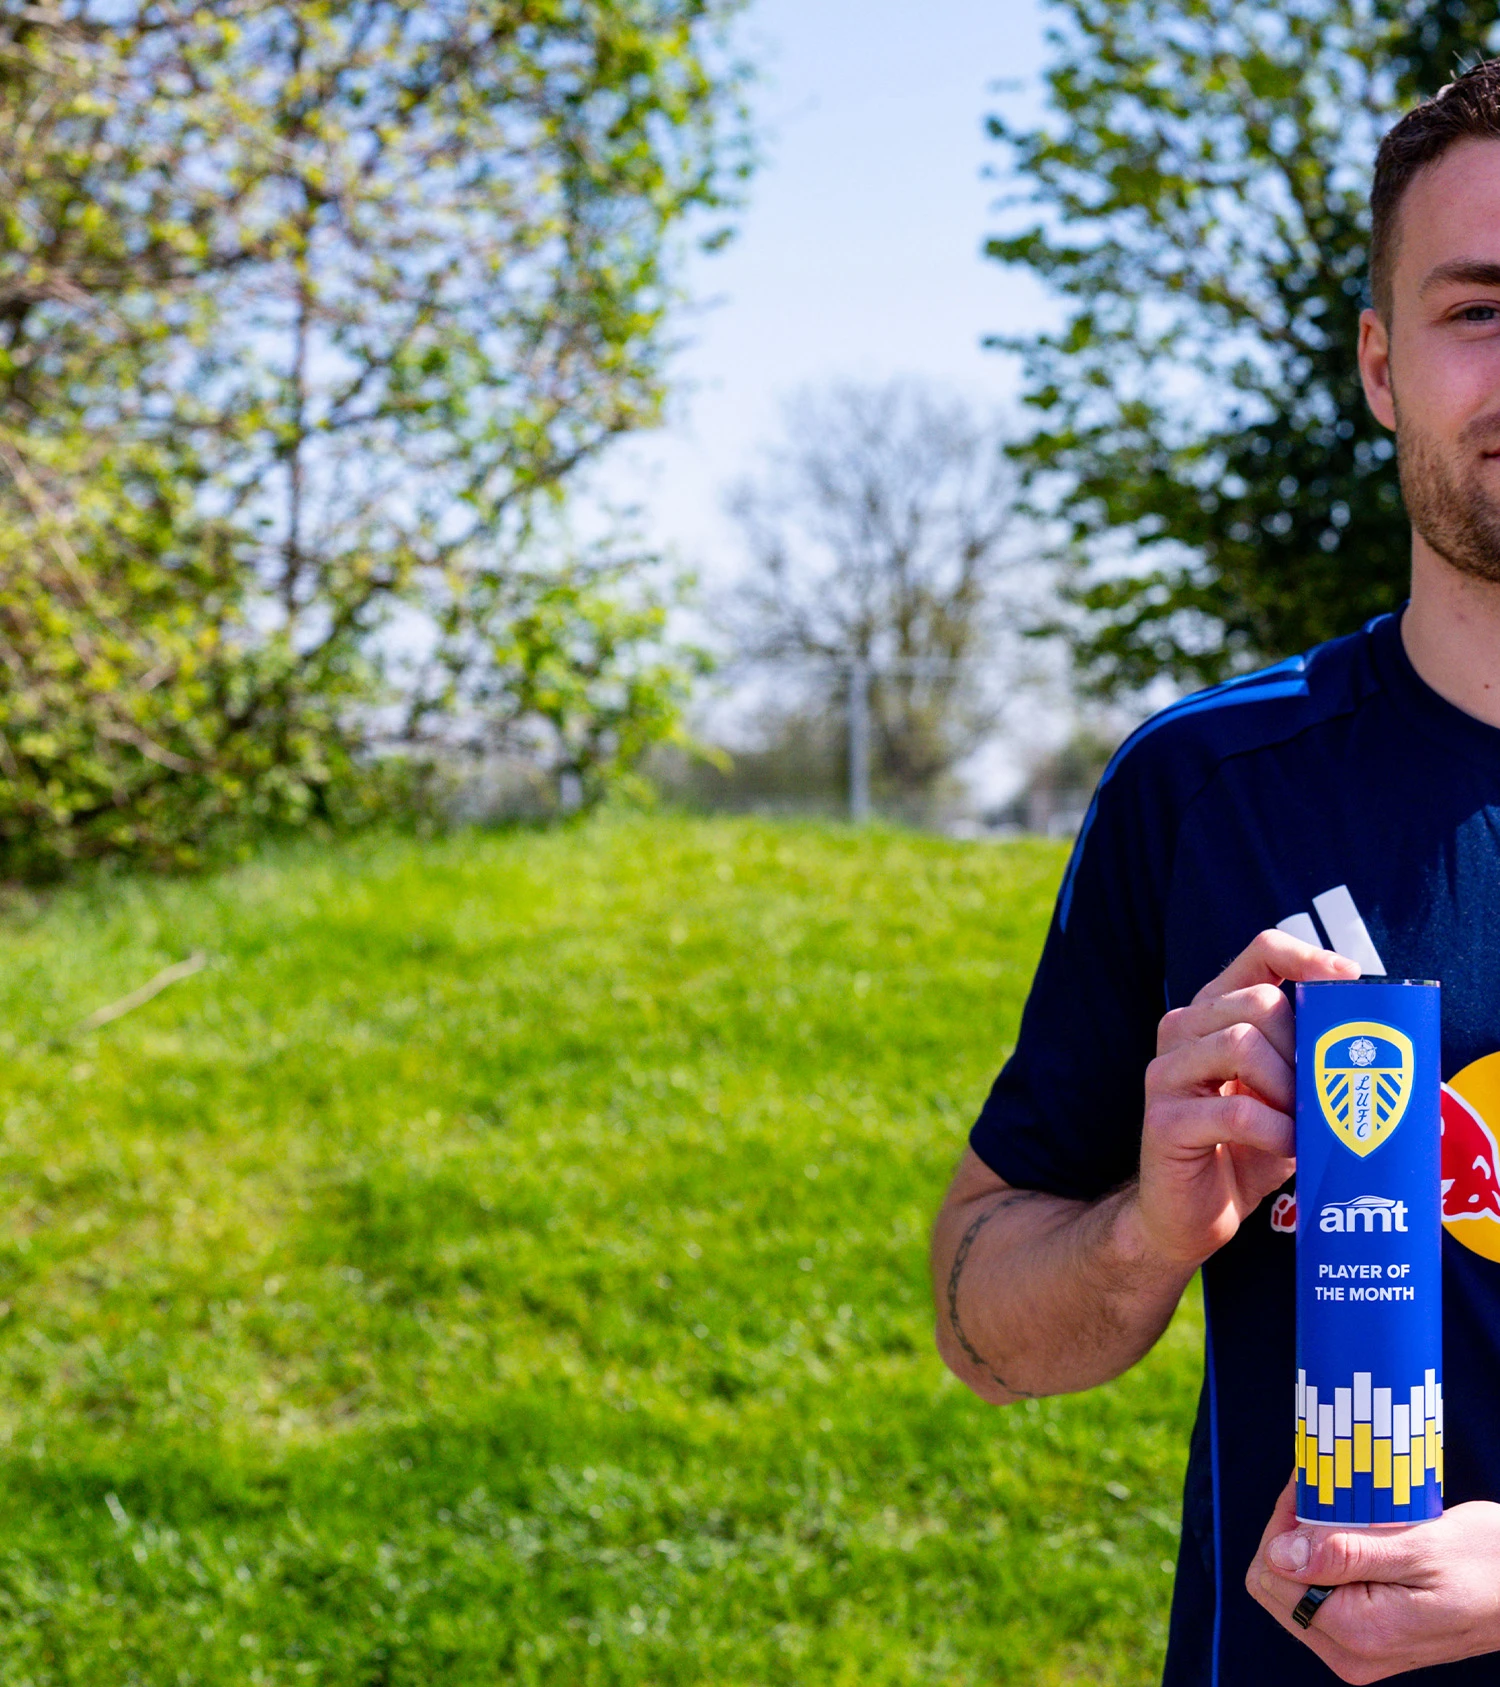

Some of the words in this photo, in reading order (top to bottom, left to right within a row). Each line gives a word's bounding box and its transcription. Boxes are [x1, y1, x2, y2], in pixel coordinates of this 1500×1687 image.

[1355, 1074, 1370, 1138] LUFC
[1319, 1200, 1408, 1233] amt
[1319, 1264, 1382, 1279] PLAYER
[1386, 1264, 1410, 1278] OF
[1315, 1287, 1345, 1301] THE
[1349, 1286, 1415, 1301] MONTH
